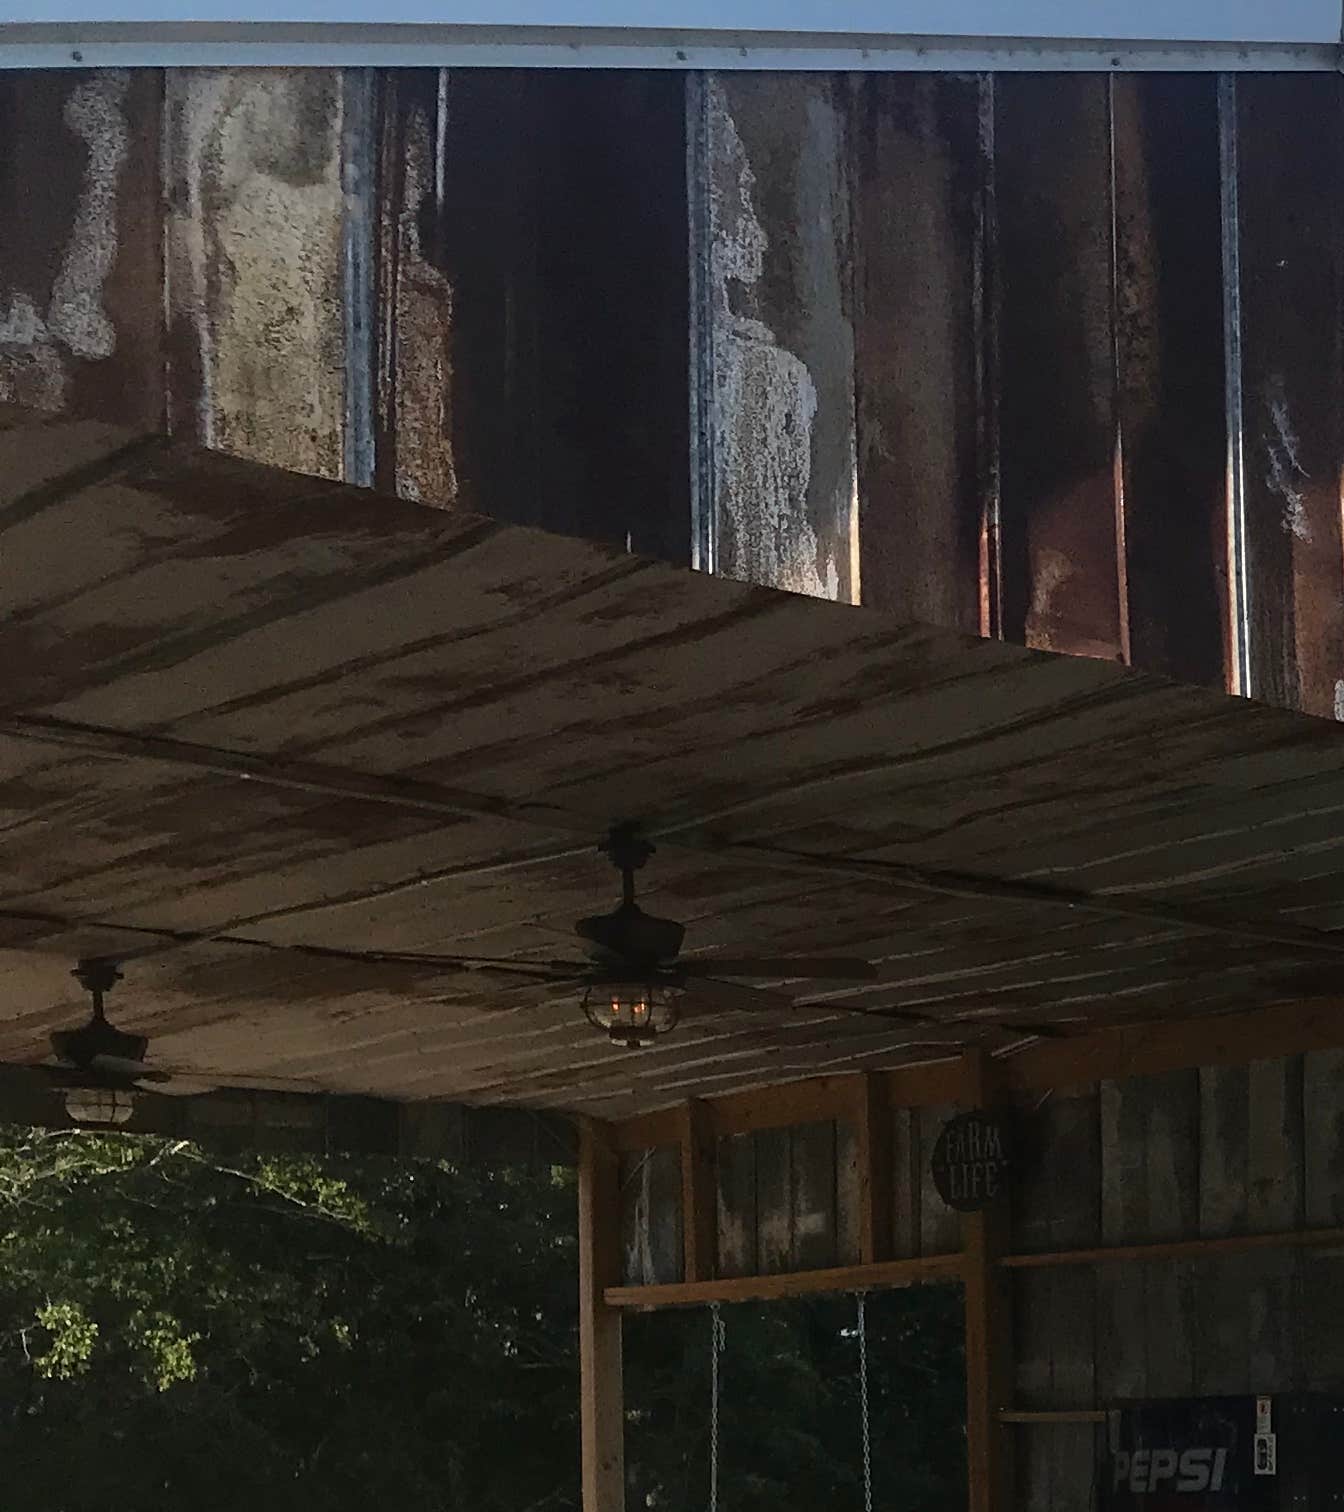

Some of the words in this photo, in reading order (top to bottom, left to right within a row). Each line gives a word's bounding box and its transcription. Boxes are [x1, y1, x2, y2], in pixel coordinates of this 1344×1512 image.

[946, 1122, 1003, 1161] FARM
[950, 1161, 998, 1198] LIFE
[1113, 1448, 1228, 1493] PEPSI
